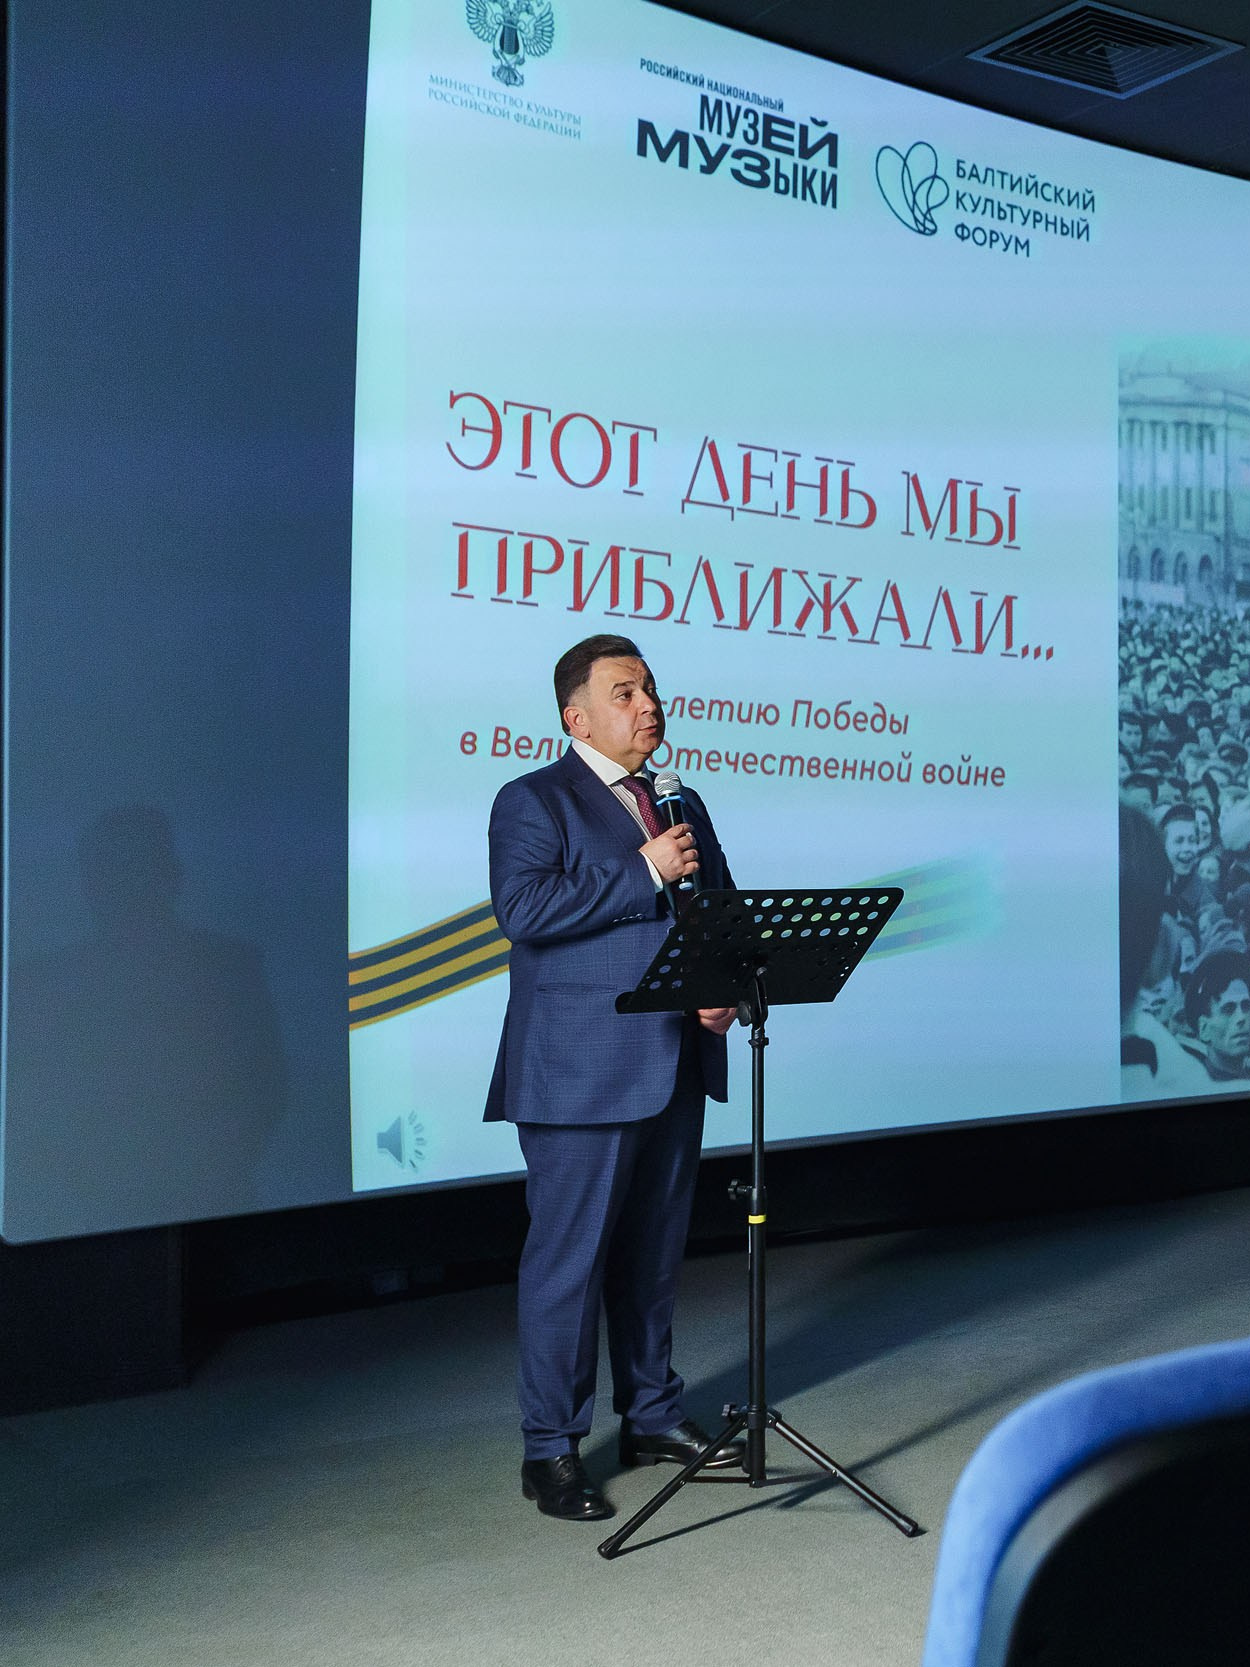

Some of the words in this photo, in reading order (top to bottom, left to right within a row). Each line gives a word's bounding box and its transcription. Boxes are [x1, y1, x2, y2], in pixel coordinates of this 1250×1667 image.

[428, 74, 524, 109] МИНИСТЕРСТВО
[526, 103, 582, 126] КУЛЬТУРЫ
[640, 57, 705, 89] РОССИЙСКИЙ
[706, 79, 784, 113] НАЦИОНАЛЬНЫЙ
[428, 88, 510, 120] РОССИЙСКОЙ
[513, 112, 582, 140] ФЕДЕРАЦИИ
[699, 93, 839, 169] МУЗЕЙ
[636, 118, 838, 210] МУЗЫКИ
[956, 158, 1096, 214] БАЛТИЙСКИЙ
[954, 222, 1030, 258] ФОРУМ
[955, 189, 1090, 243] КУЛЬТУРНЫЙ
[446, 390, 657, 496] ЭТОТ
[682, 435, 878, 530] ДЕНЬ
[901, 471, 1022, 550] МЫ
[450, 521, 1055, 662] ПРИБЛИЖАЛИ...
[661, 695, 780, 726] -летию
[791, 700, 909, 735] Победы
[459, 731, 478, 755] в
[649, 739, 912, 784] Отечественной
[922, 754, 1006, 787] войне
